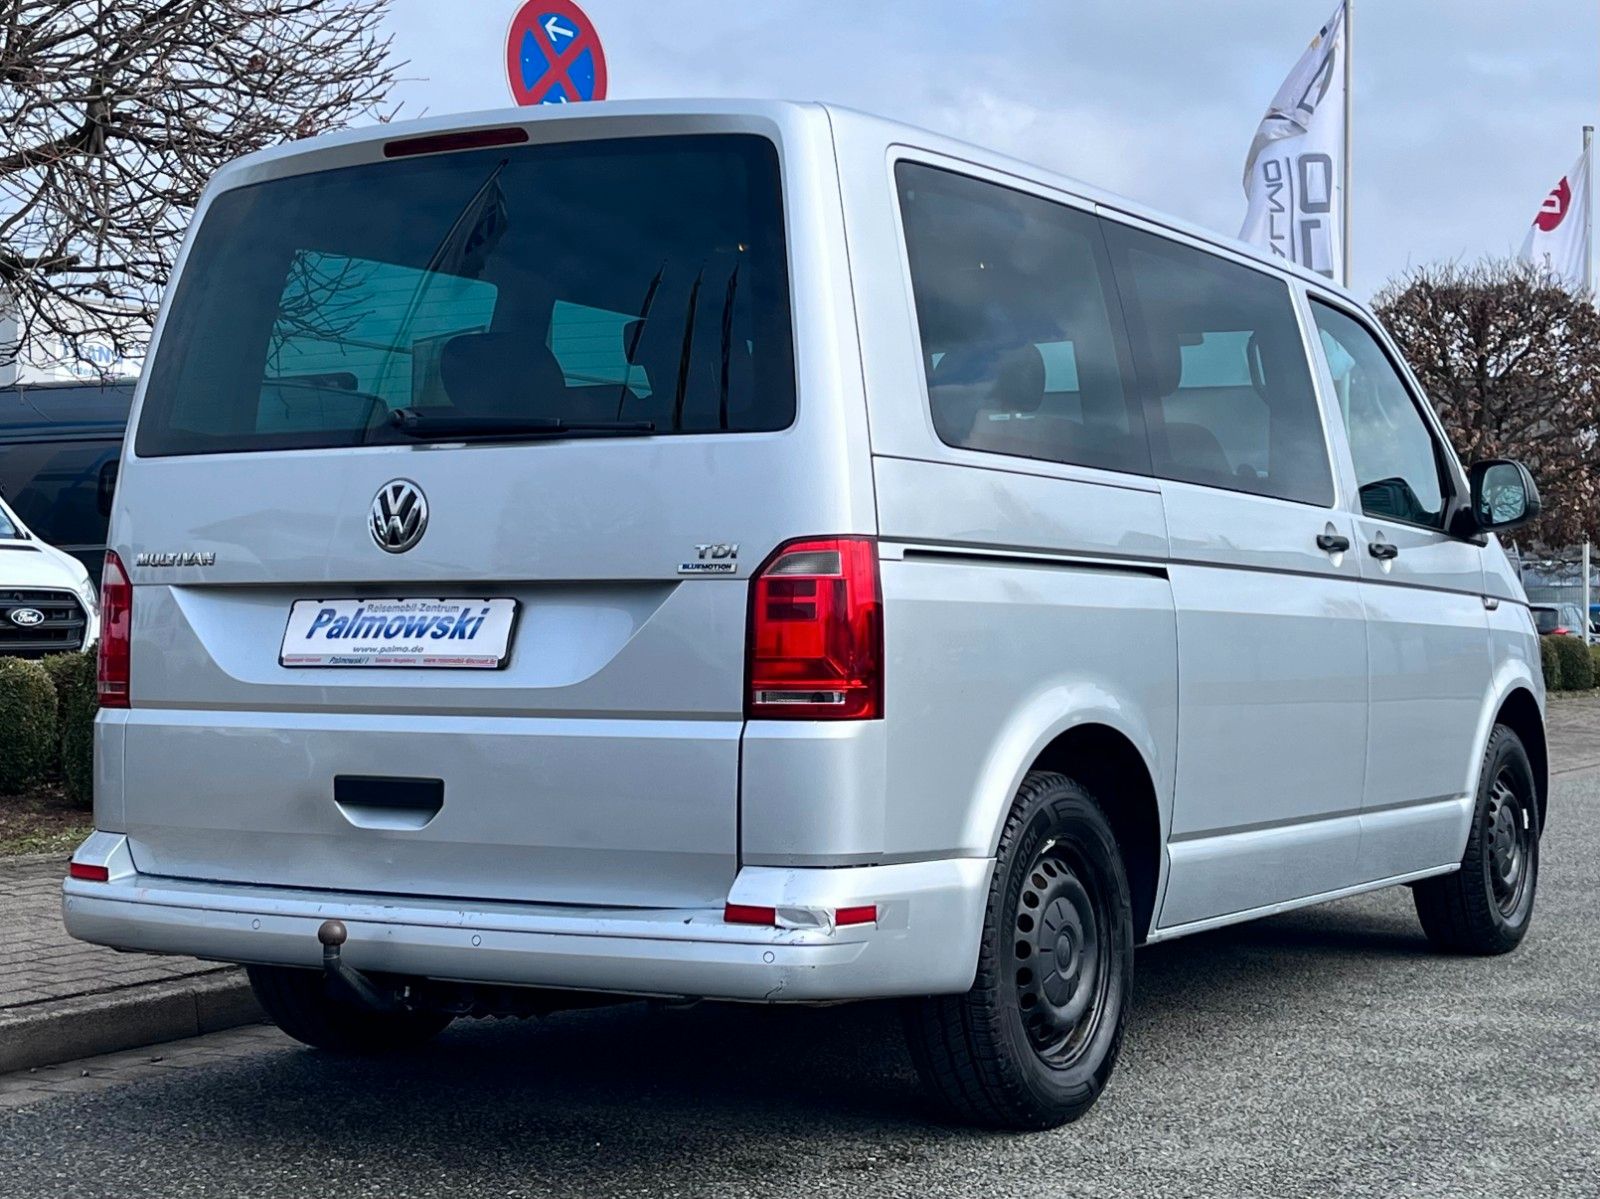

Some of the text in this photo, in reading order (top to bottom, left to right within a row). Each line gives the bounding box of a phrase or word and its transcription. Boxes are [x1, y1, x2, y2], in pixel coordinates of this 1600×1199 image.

[694, 543, 740, 559] TDI
[136, 552, 216, 567] MULTIVAN
[305, 608, 490, 640] Palmowski
[353, 645, 424, 655] www.palmo.de
